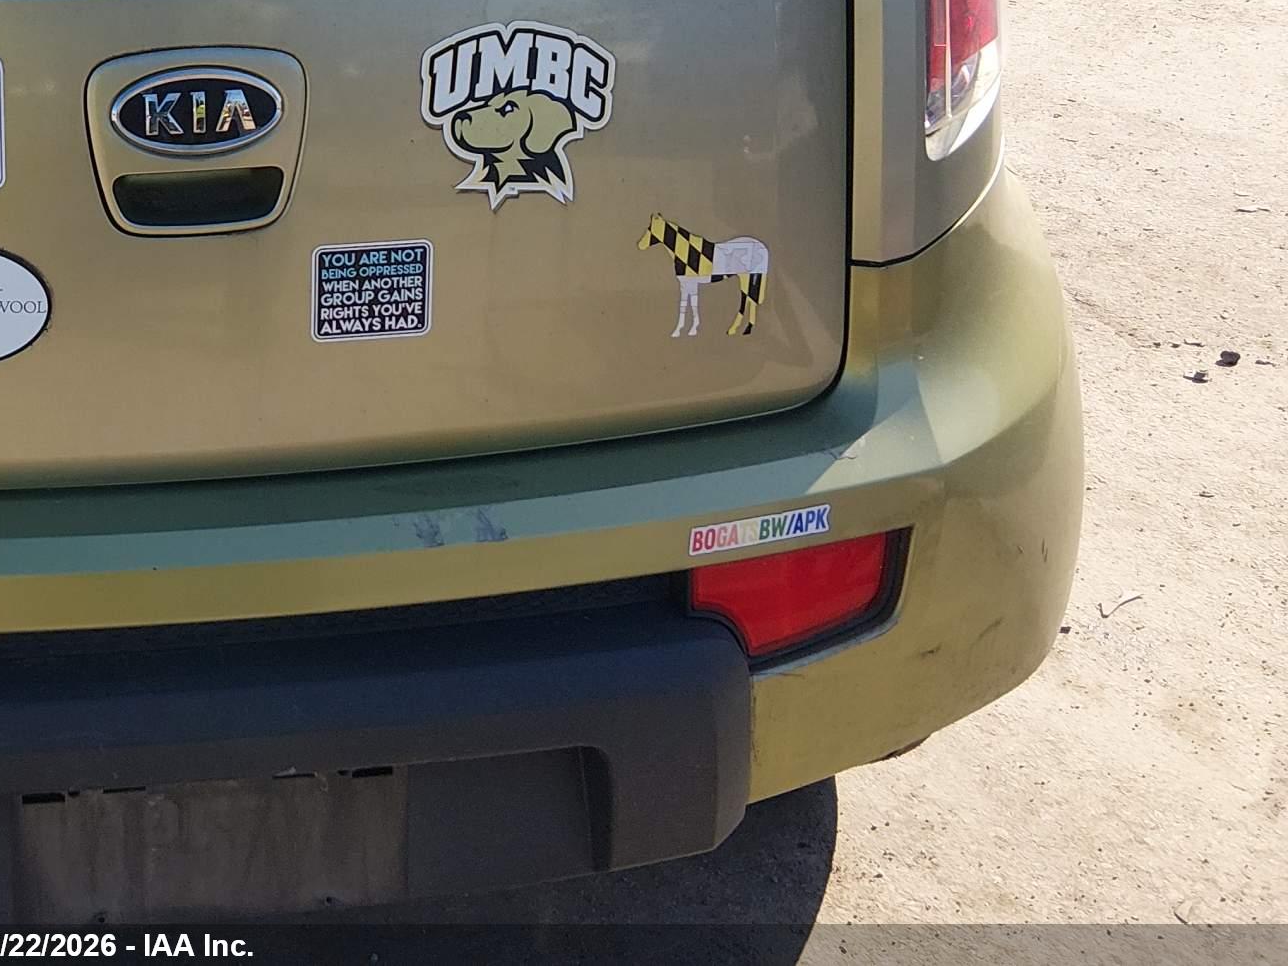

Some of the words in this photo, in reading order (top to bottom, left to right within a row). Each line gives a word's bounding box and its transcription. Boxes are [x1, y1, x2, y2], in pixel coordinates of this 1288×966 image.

[432, 32, 606, 120] UMBC
[142, 89, 257, 136] KIA
[322, 253, 356, 267] YOU
[359, 250, 388, 265] ARE
[391, 248, 424, 263] NOT
[321, 267, 357, 279] BEING
[359, 263, 424, 277] OPPRESSED
[322, 279, 359, 292] WHEN
[362, 275, 423, 290] ANOTHER
[320, 291, 374, 306] GROUP
[377, 287, 423, 302] GAINS
[320, 305, 369, 320] RIGHTS
[372, 302, 423, 317] YOU'VE
[320, 317, 381, 334] ALWAYS
[384, 315, 422, 331] HAD.
